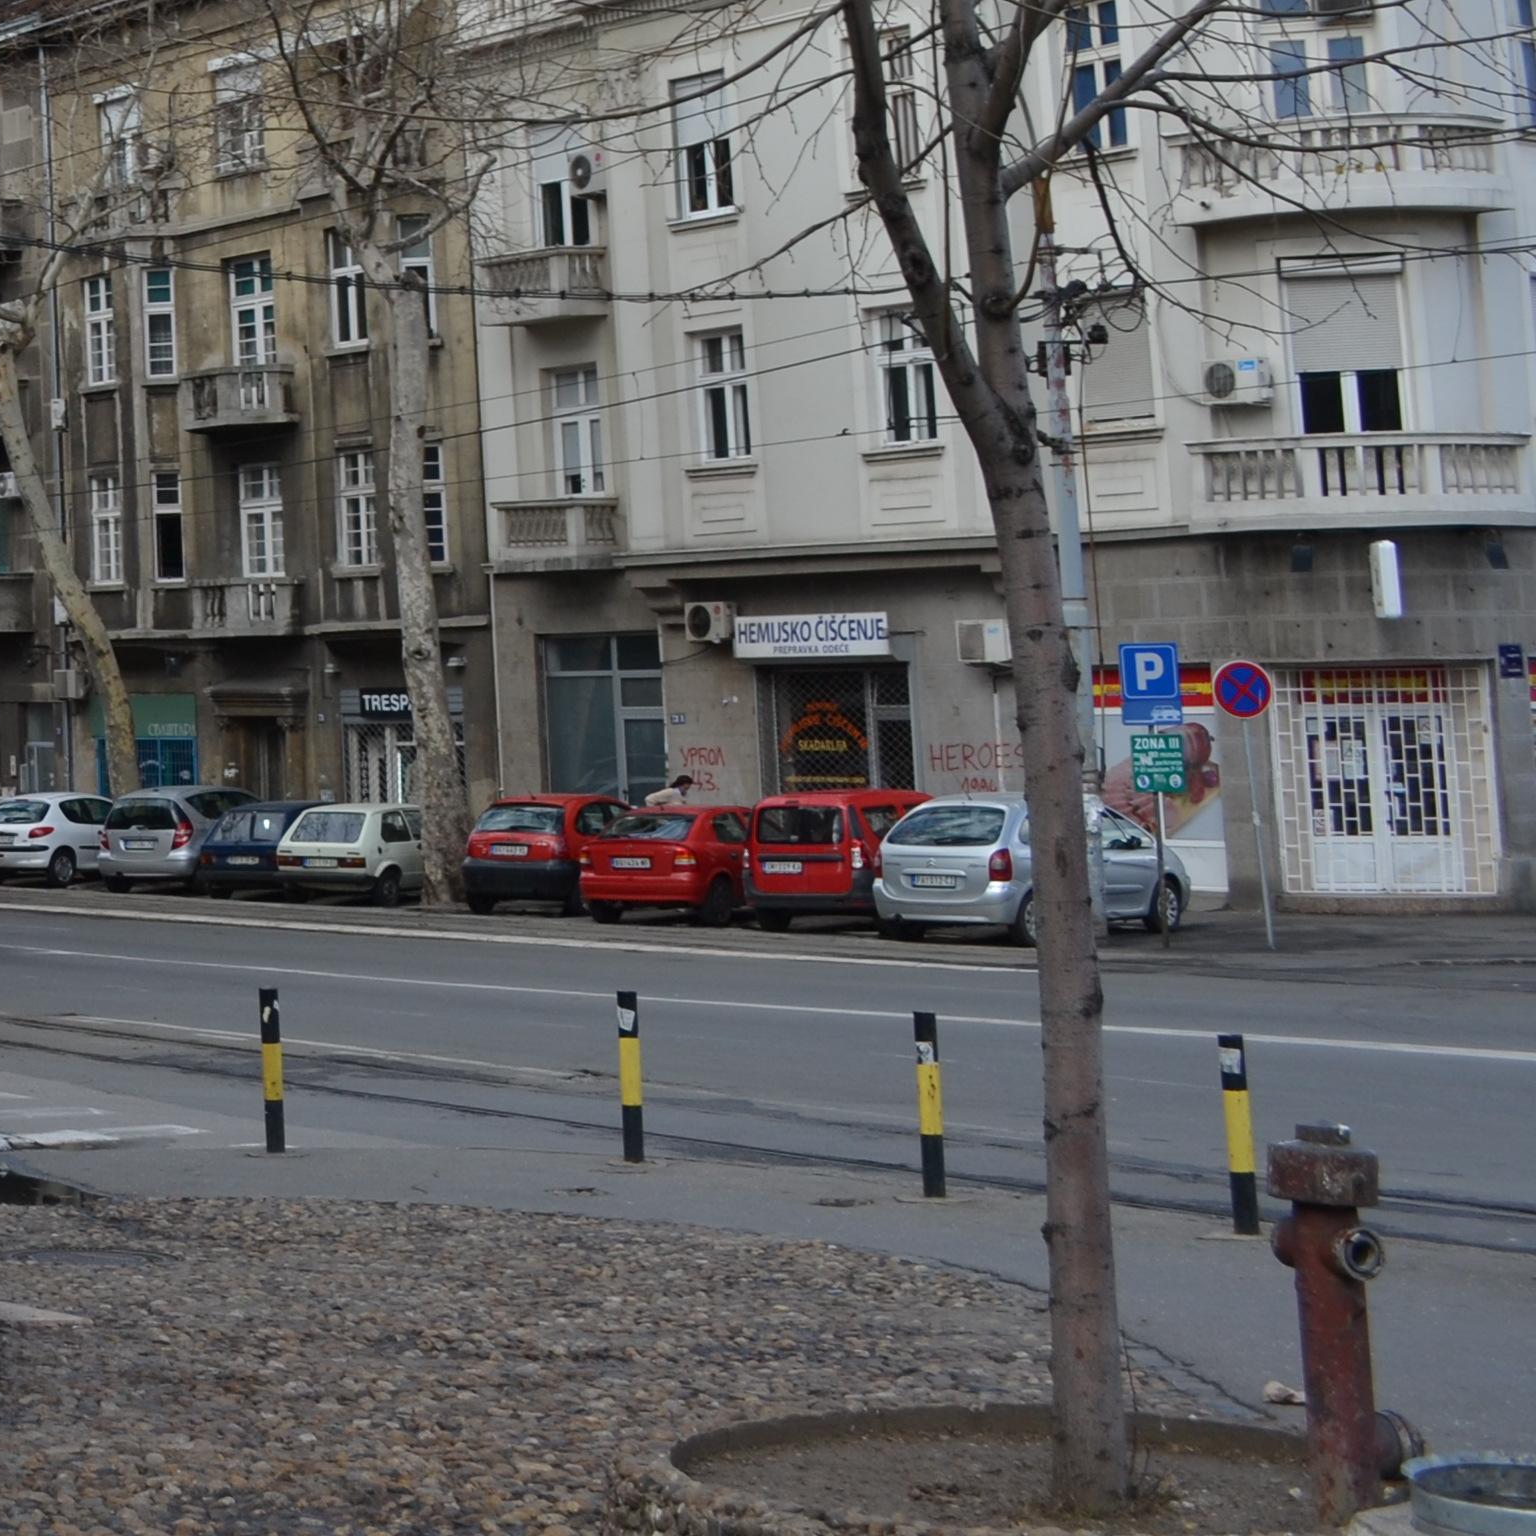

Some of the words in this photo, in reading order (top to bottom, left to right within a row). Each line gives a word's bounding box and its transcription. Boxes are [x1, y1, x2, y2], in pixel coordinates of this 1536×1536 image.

[737, 620, 813, 645] HEMIJSKO
[814, 614, 889, 642] ČIŠĆENJE
[1134, 651, 1165, 692] P
[361, 693, 412, 712] TRESP
[929, 742, 1025, 772] HEROES
[1133, 737, 1167, 750] ZONA
